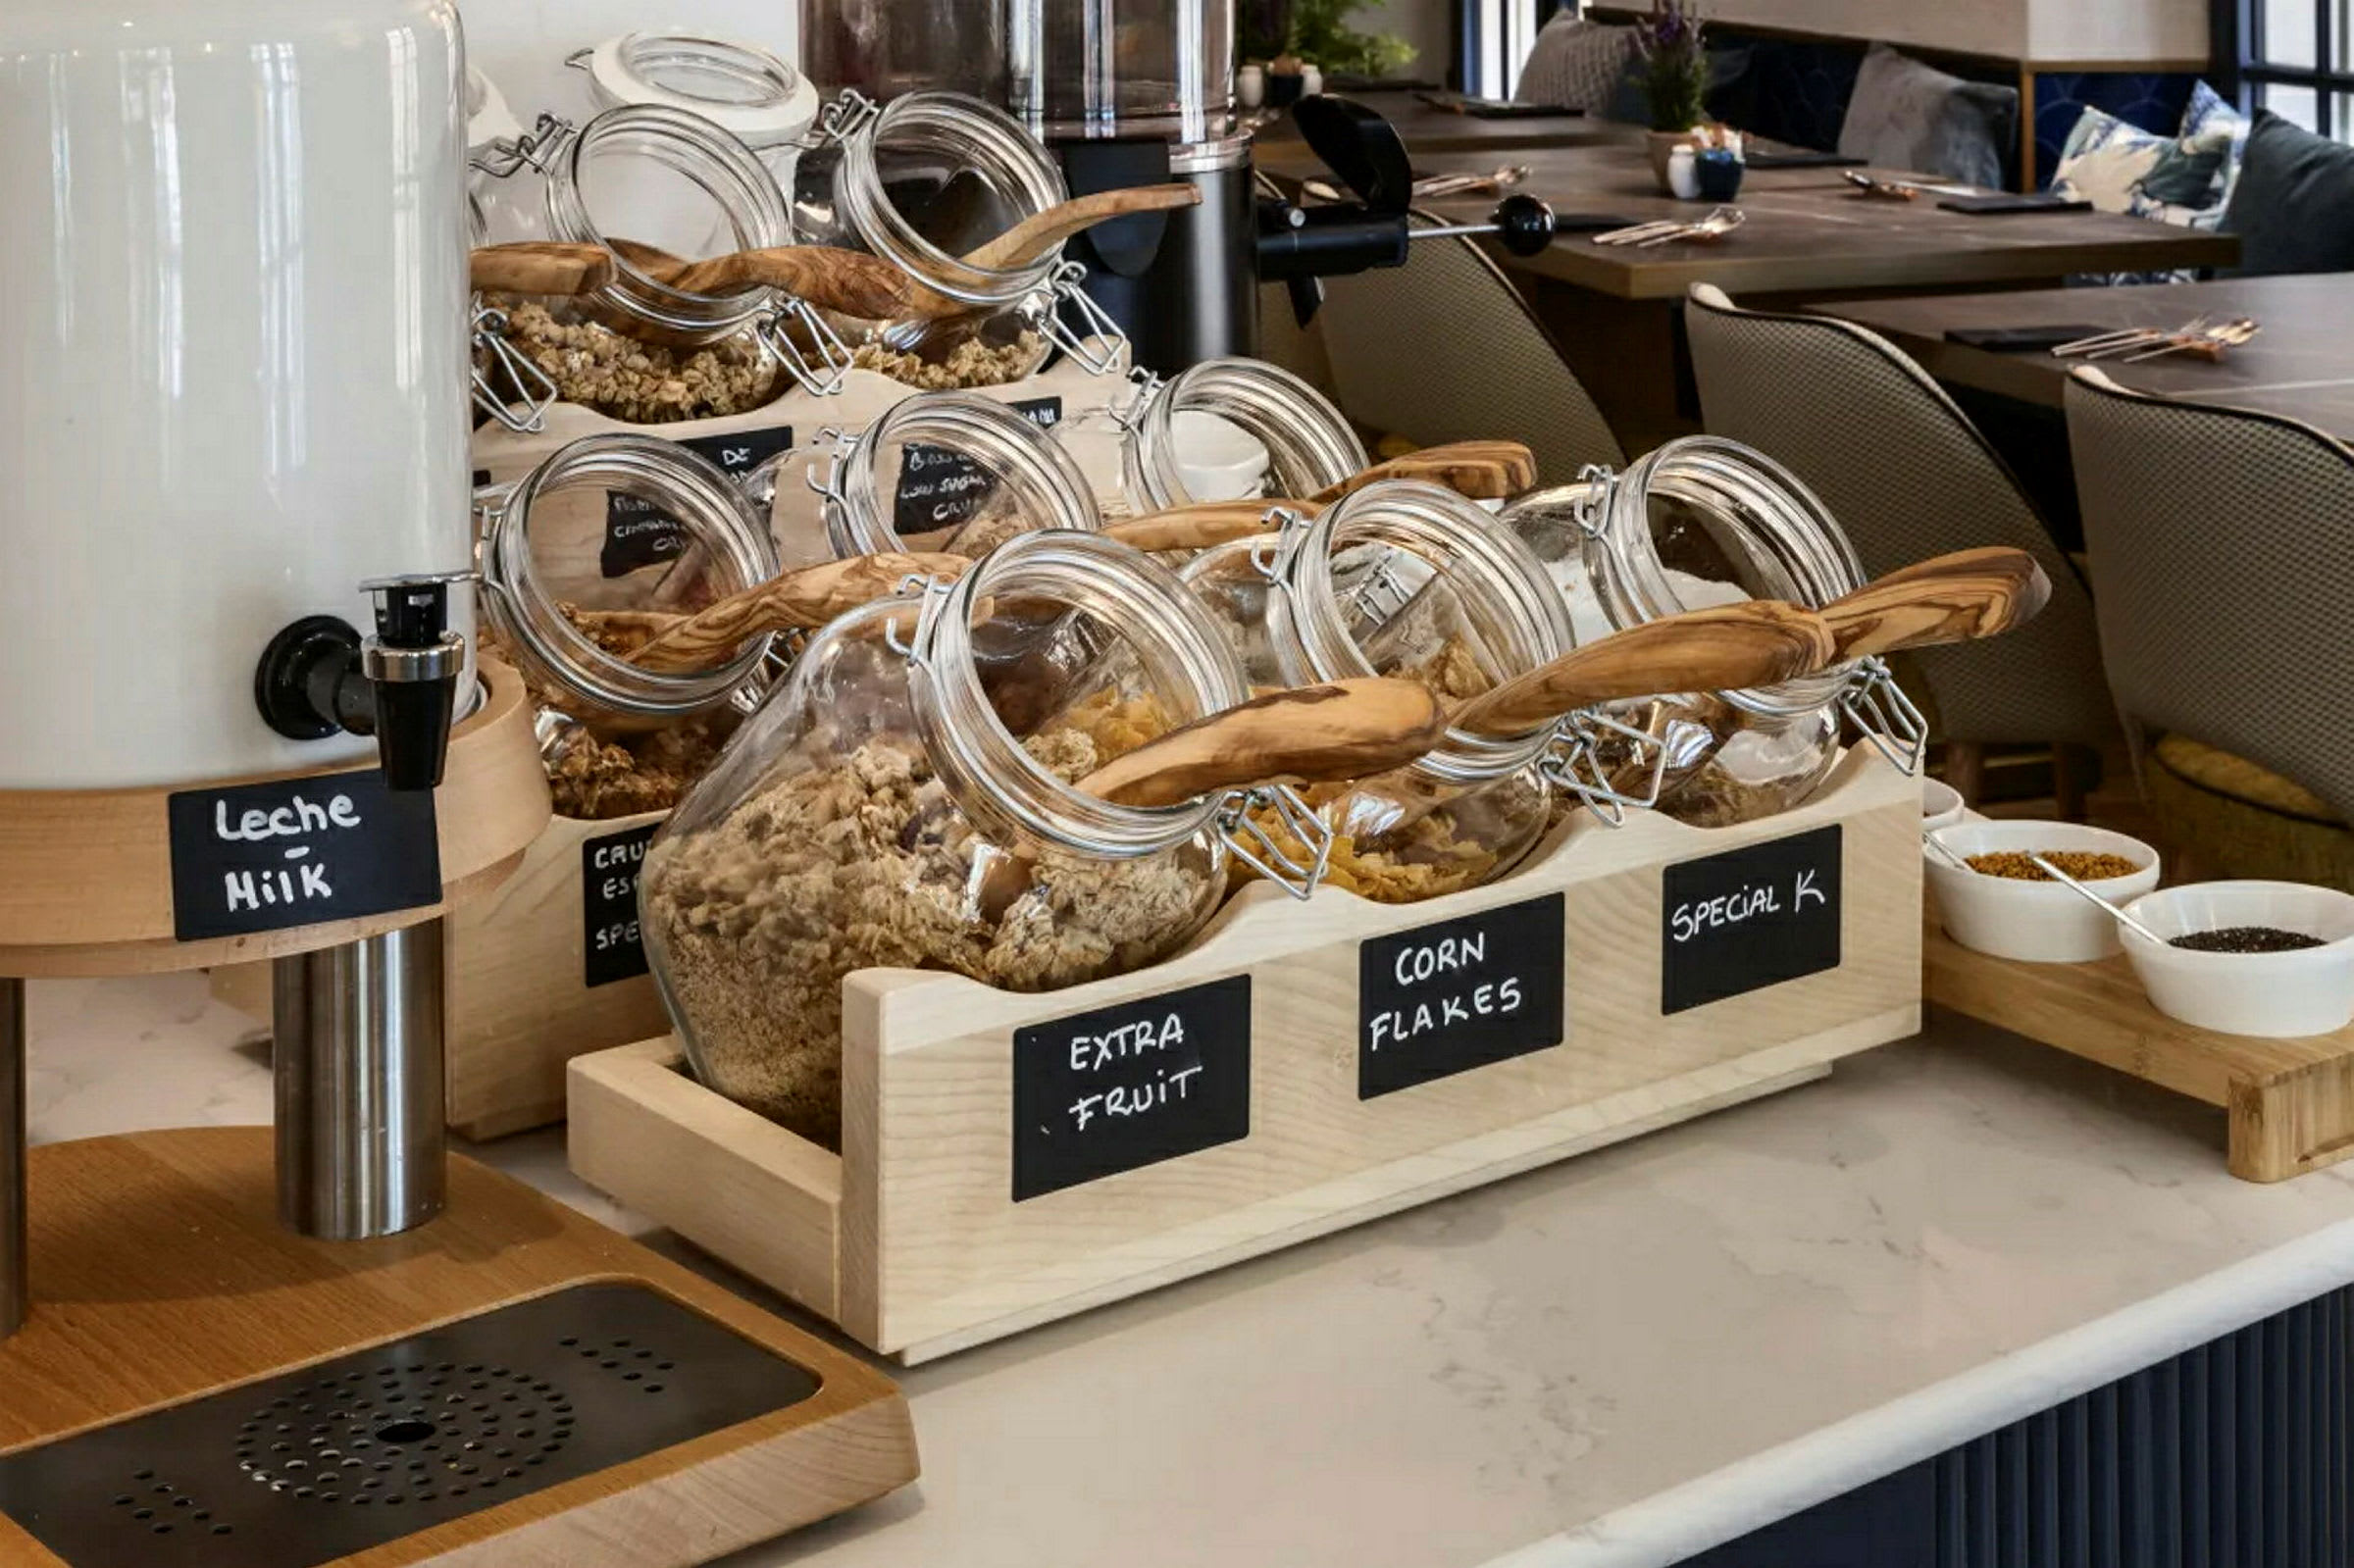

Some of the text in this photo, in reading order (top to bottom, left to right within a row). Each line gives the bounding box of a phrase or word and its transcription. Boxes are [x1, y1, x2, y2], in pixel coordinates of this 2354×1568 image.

[216, 794, 362, 840] Leche
[1795, 869, 1825, 913] K
[596, 920, 639, 951] SPE
[1394, 931, 1484, 986] CORN
[1369, 977, 1522, 1052] FLAKES
[1070, 1013, 1185, 1071] EXTRA
